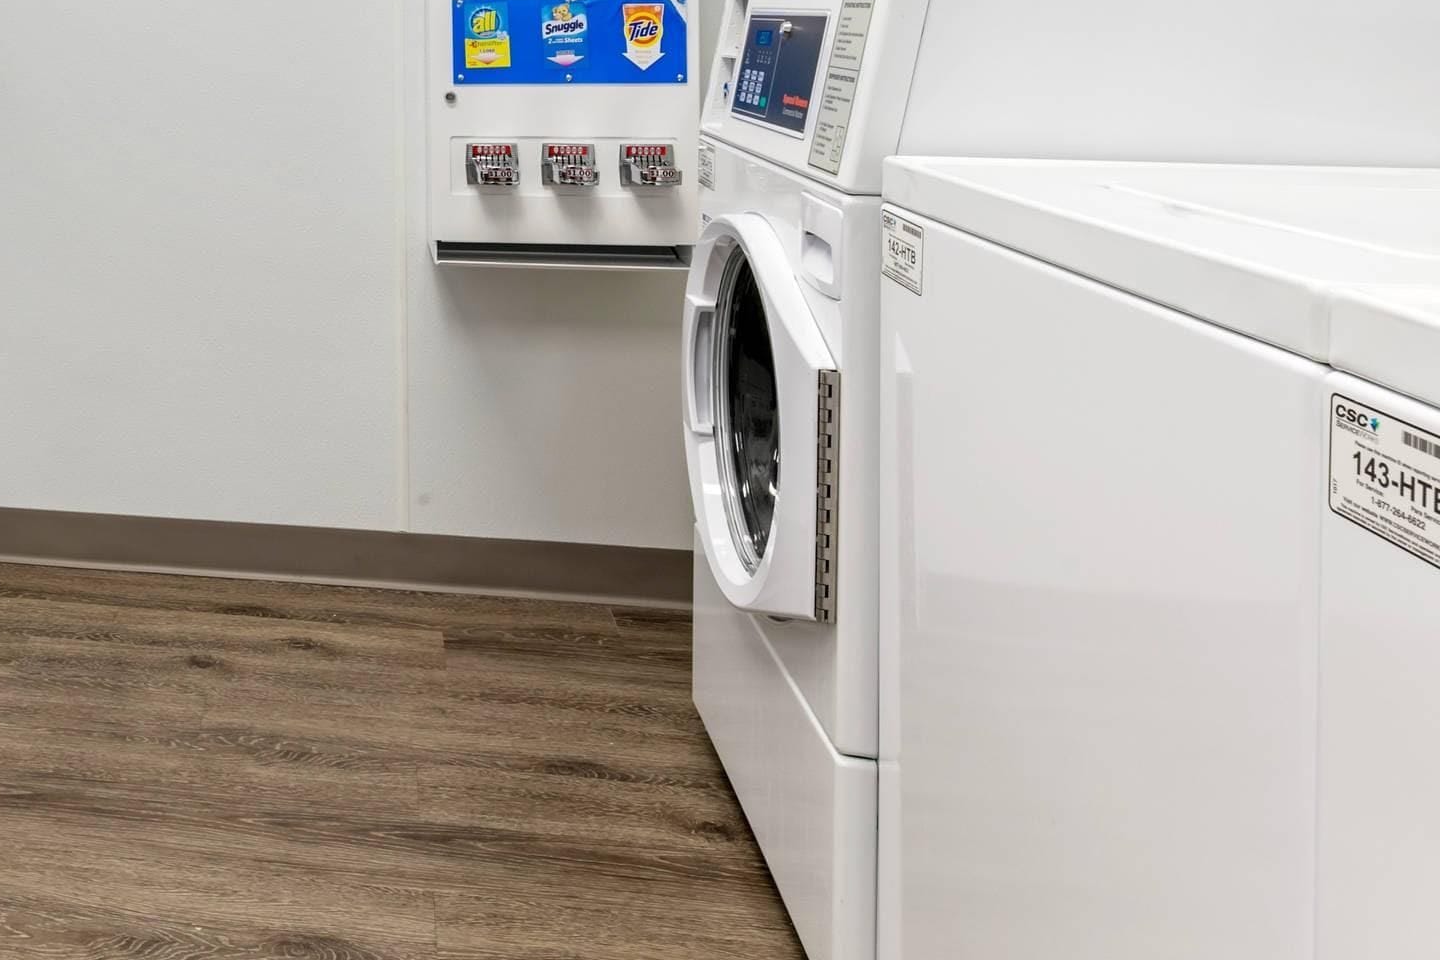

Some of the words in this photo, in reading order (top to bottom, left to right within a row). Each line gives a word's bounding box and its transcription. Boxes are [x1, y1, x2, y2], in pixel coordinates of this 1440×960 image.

[472, 11, 496, 33] all
[545, 20, 584, 35] Snuggle
[629, 21, 658, 41] Tide
[567, 169, 591, 177] $1.00
[888, 238, 916, 264] 142-HTB
[1336, 405, 1368, 427] CSC
